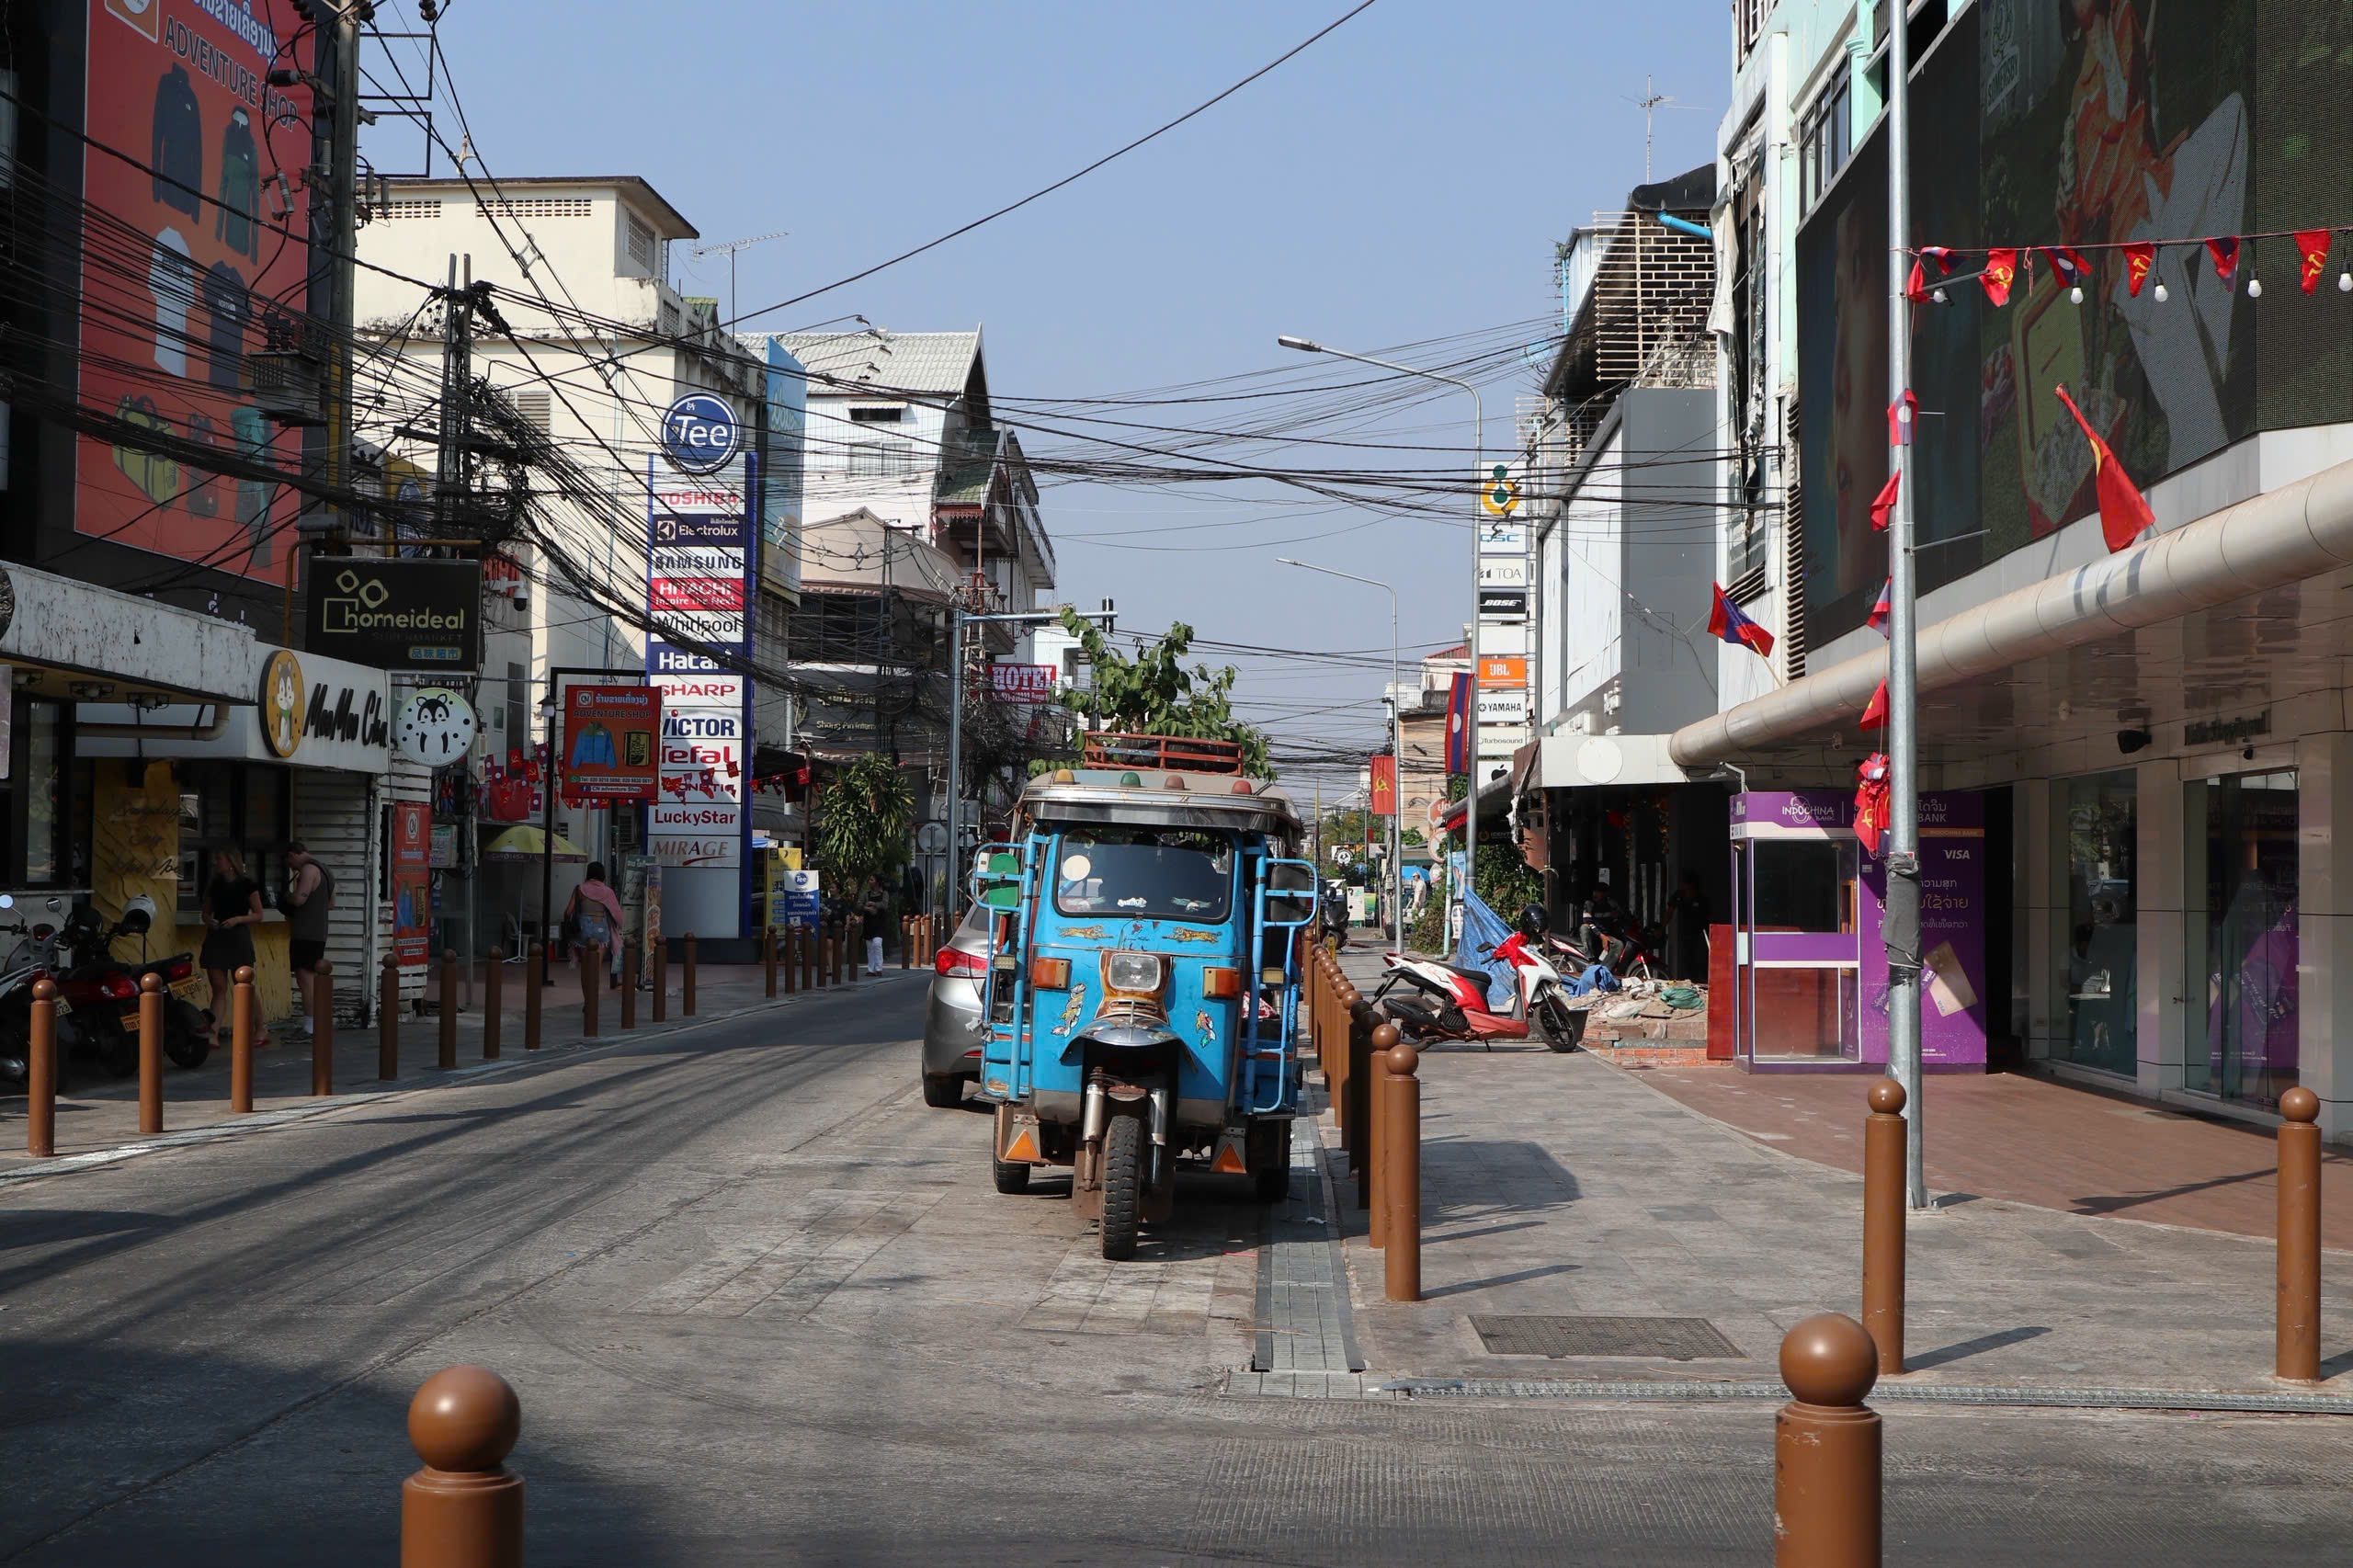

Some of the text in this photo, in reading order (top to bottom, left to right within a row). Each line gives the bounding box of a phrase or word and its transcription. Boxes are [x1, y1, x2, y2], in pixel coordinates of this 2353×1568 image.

[164, 15, 298, 132] ADVENTURE SHOP
[675, 415, 728, 447] Tee
[658, 491, 739, 506] TOSHIBA
[678, 525, 739, 536] Electrolux
[1481, 534, 1519, 543] QSC
[655, 555, 742, 570] SAMSUNG
[1495, 567, 1522, 580] TOA
[659, 582, 732, 596] HITACHI
[344, 604, 464, 630] homeideal
[657, 615, 737, 637] Whirlpool
[1489, 664, 1510, 676] JBL
[992, 665, 1052, 691] HOTEL
[657, 684, 736, 697] SHARP
[574, 710, 651, 719] ADVENTURE SHOP
[1488, 703, 1522, 712] YAMAHA
[662, 745, 731, 765] Tefal
[654, 809, 736, 826] LuckyStar
[1918, 812, 1947, 823] BANK
[654, 840, 729, 857] MIRAGE
[1943, 849, 1971, 859] VISA
